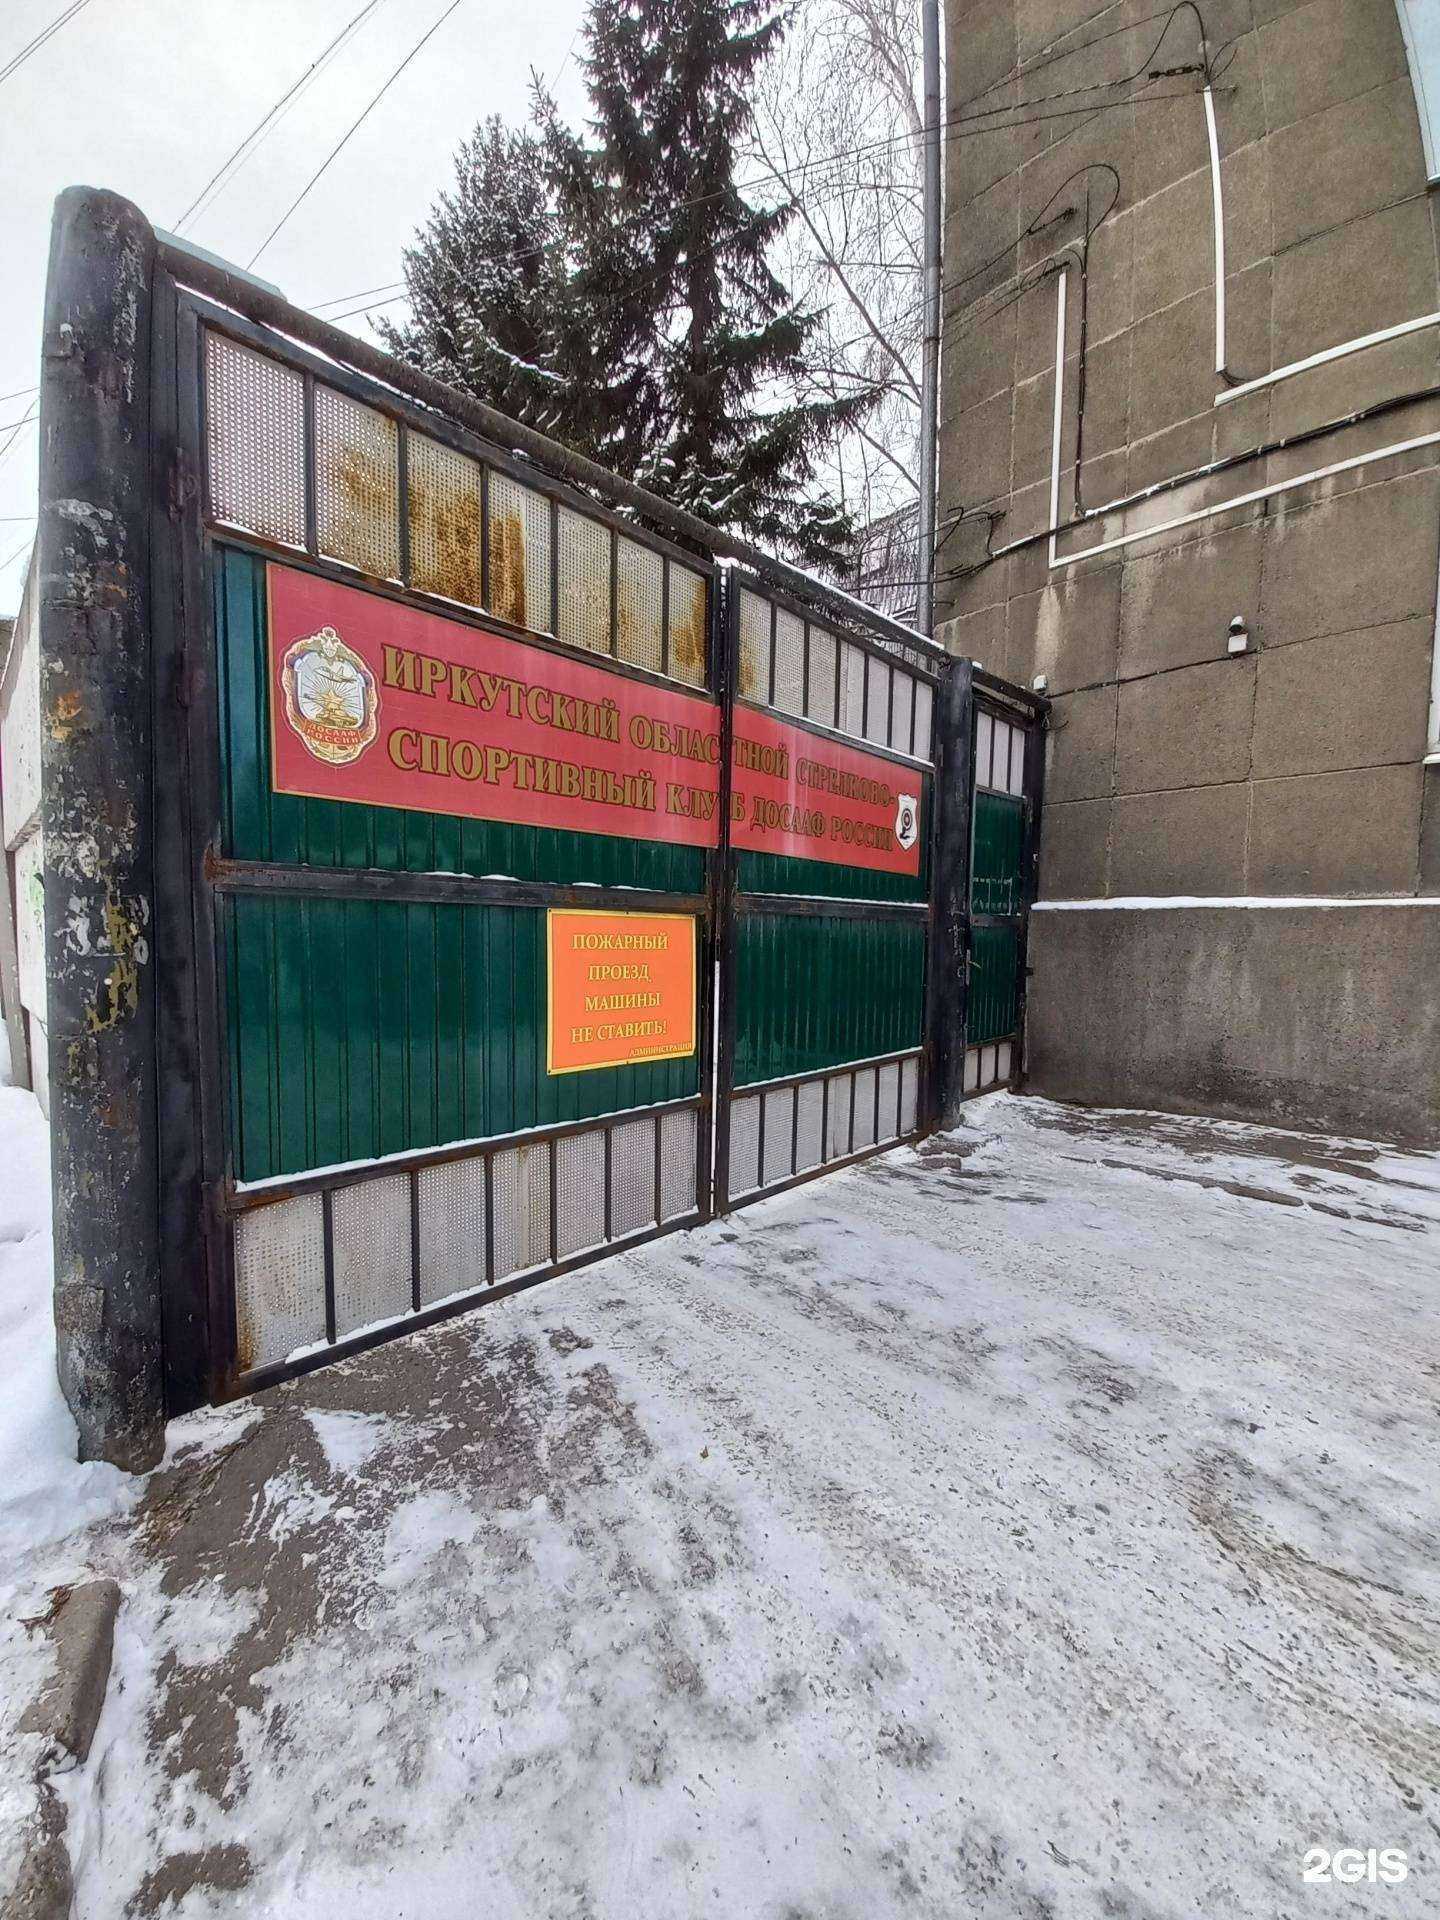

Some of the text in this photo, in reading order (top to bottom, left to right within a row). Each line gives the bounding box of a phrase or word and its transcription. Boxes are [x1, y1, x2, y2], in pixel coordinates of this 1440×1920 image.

[381, 643, 620, 744] ИРКУТСКИЙ
[387, 727, 894, 851] СПОРТИВНЫЙ КЛУБ ДОСААФ РОССИИ
[572, 932, 669, 950] ПОЖАРНЫЙ
[584, 992, 661, 1012] МАШИНЫ
[571, 1021, 667, 1044] НЕ СТАВИТЬ!
